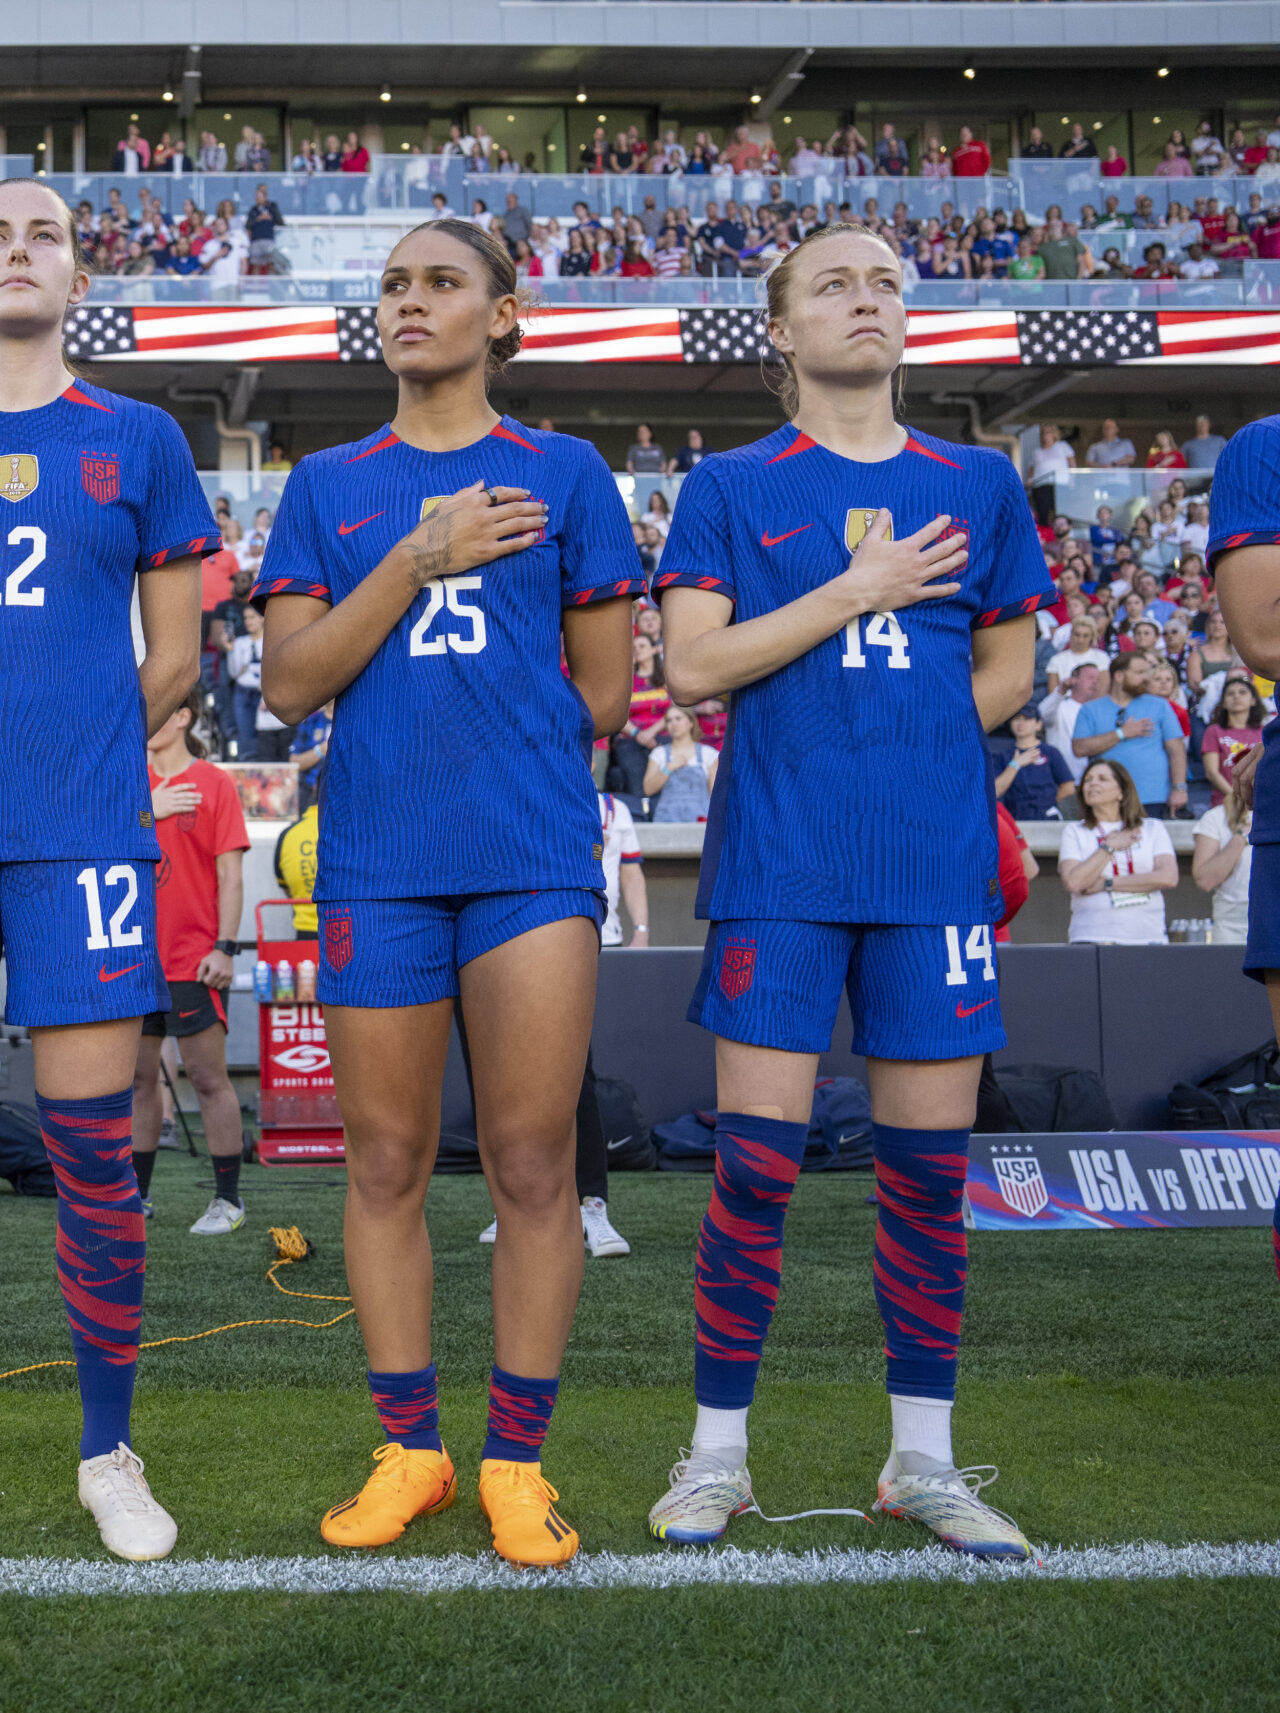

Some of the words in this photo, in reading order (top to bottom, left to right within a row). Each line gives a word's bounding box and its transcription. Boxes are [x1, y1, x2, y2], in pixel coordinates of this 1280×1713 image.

[83, 460, 117, 479] USA
[410, 576, 487, 657] 25
[842, 611, 911, 669] 14
[77, 864, 143, 950] 12
[325, 920, 349, 942] USA
[725, 950, 753, 971] USA
[945, 924, 996, 986] 14
[273, 1077, 308, 1088] SPORTS
[995, 1160, 1038, 1183] USA
[1069, 1149, 1150, 1212] USA
